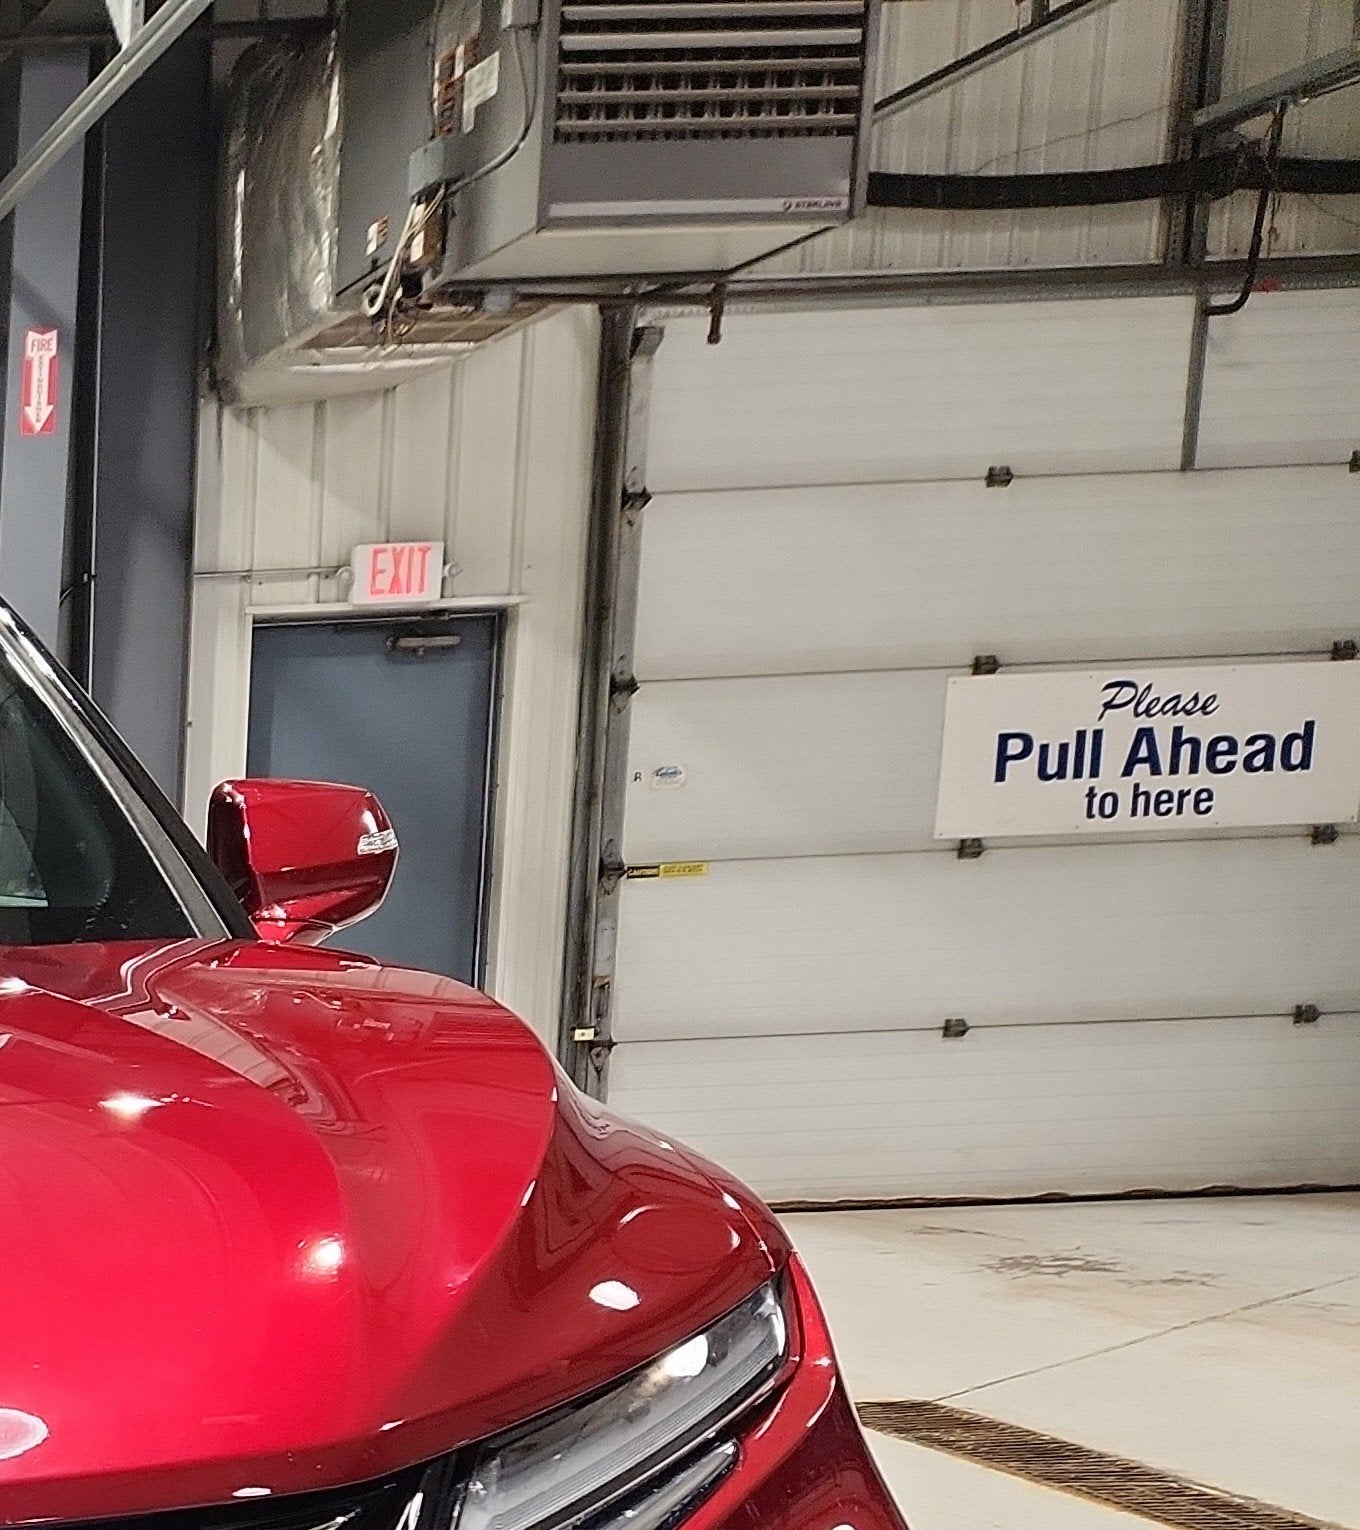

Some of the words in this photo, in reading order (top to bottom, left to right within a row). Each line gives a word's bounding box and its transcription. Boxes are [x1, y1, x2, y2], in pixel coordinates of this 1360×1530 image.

[31, 339, 54, 352] FIRE
[370, 546, 431, 596] EXIT
[1097, 679, 1220, 722] Please
[994, 728, 1104, 783] Pull
[1120, 719, 1316, 778] Ahead
[1085, 785, 1120, 819] to
[1130, 782, 1215, 818] here
